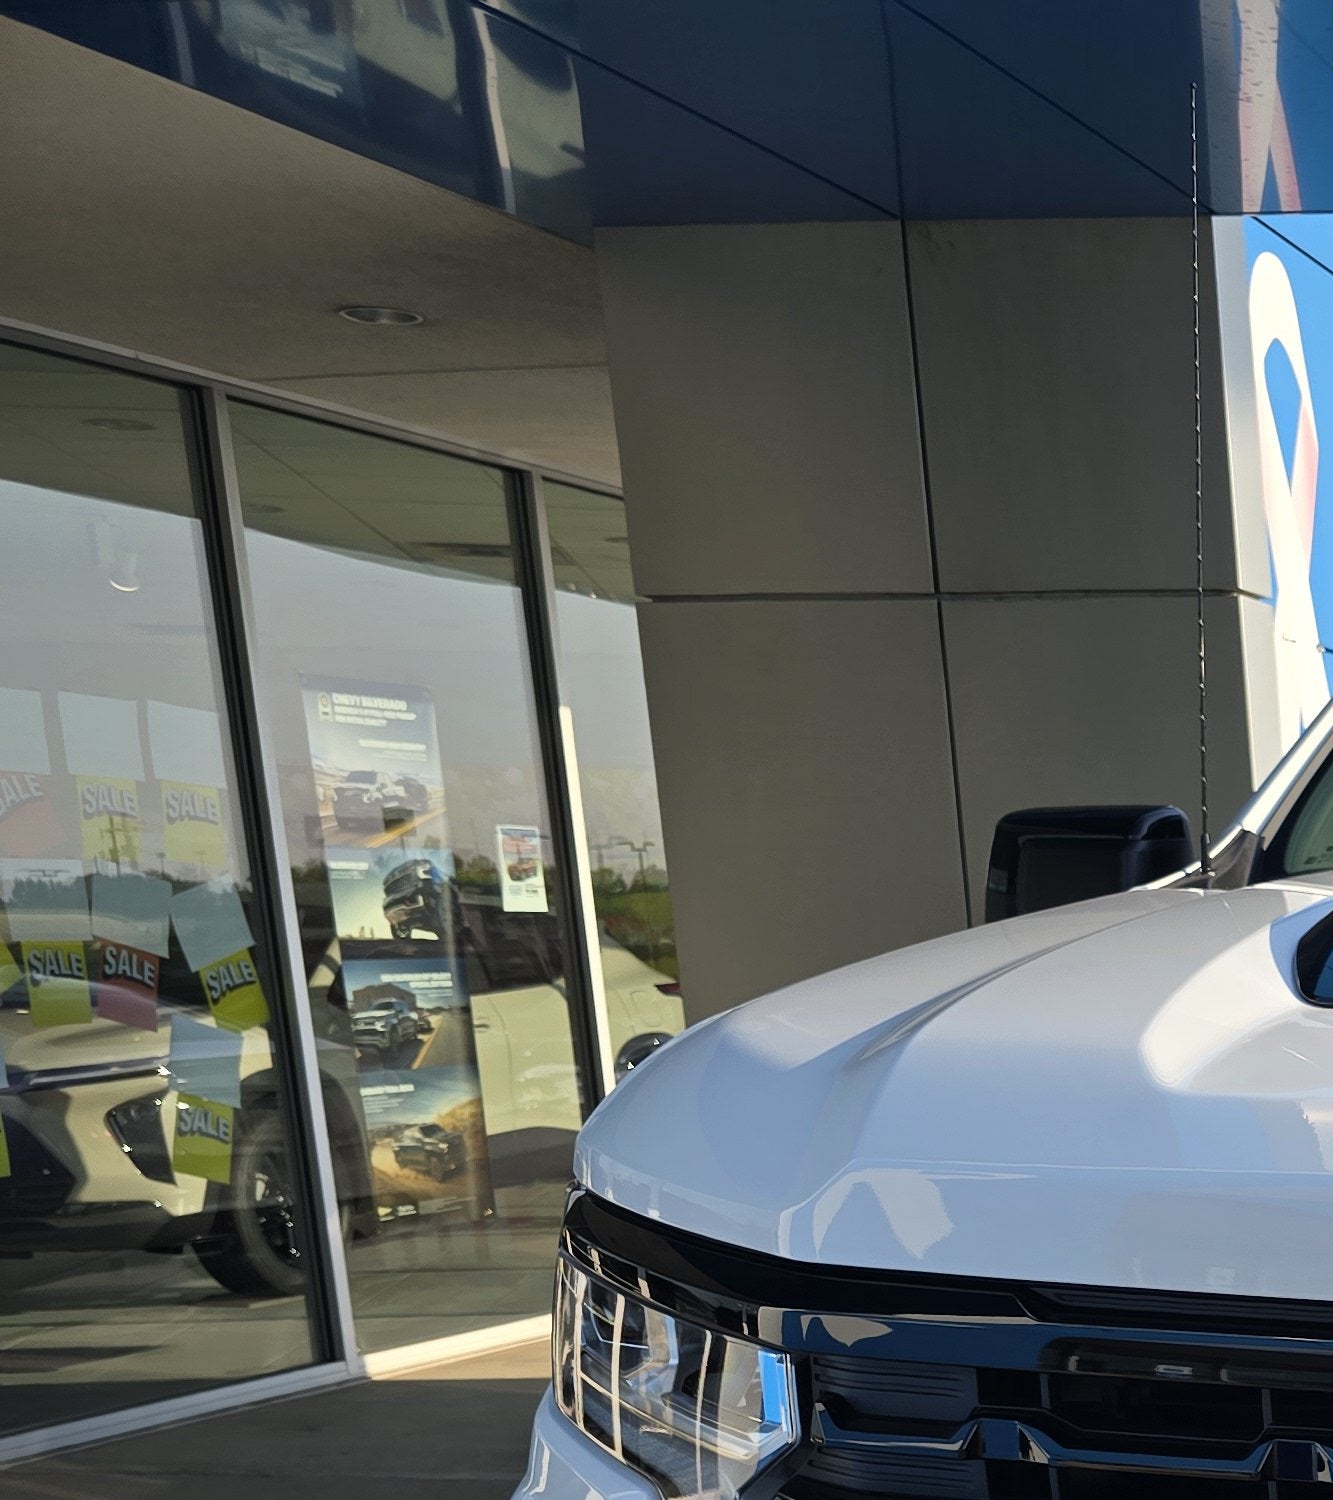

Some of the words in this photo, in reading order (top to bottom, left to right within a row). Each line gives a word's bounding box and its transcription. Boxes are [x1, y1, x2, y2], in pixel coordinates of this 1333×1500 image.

[83, 783, 137, 815] SALE
[166, 789, 219, 822] SALE
[29, 949, 83, 978] SALE
[104, 946, 155, 986] SALE
[206, 960, 256, 998] SALE
[179, 1109, 230, 1140] SALE
